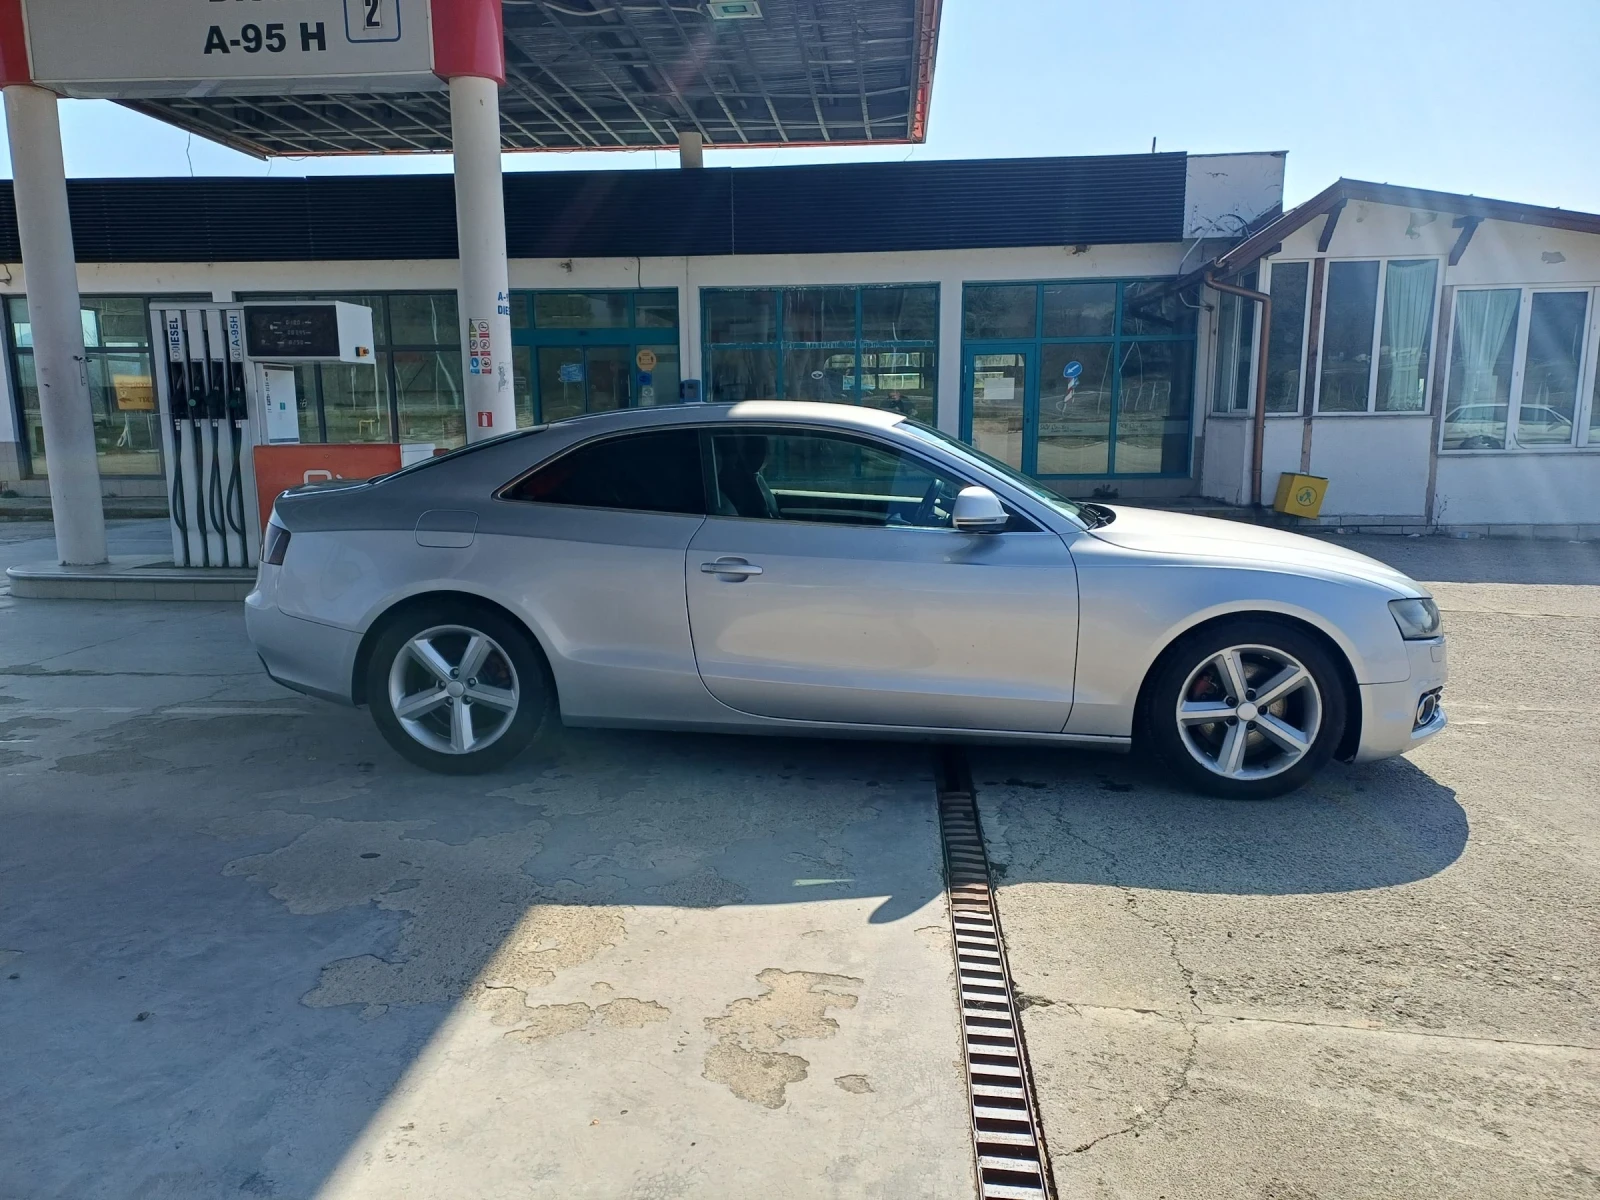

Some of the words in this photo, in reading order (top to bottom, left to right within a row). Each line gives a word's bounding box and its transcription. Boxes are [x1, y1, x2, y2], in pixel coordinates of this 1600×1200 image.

[365, 0, 380, 27] 2
[203, 23, 286, 54] A-95
[299, 22, 327, 51] H
[229, 315, 240, 347] A-95H
